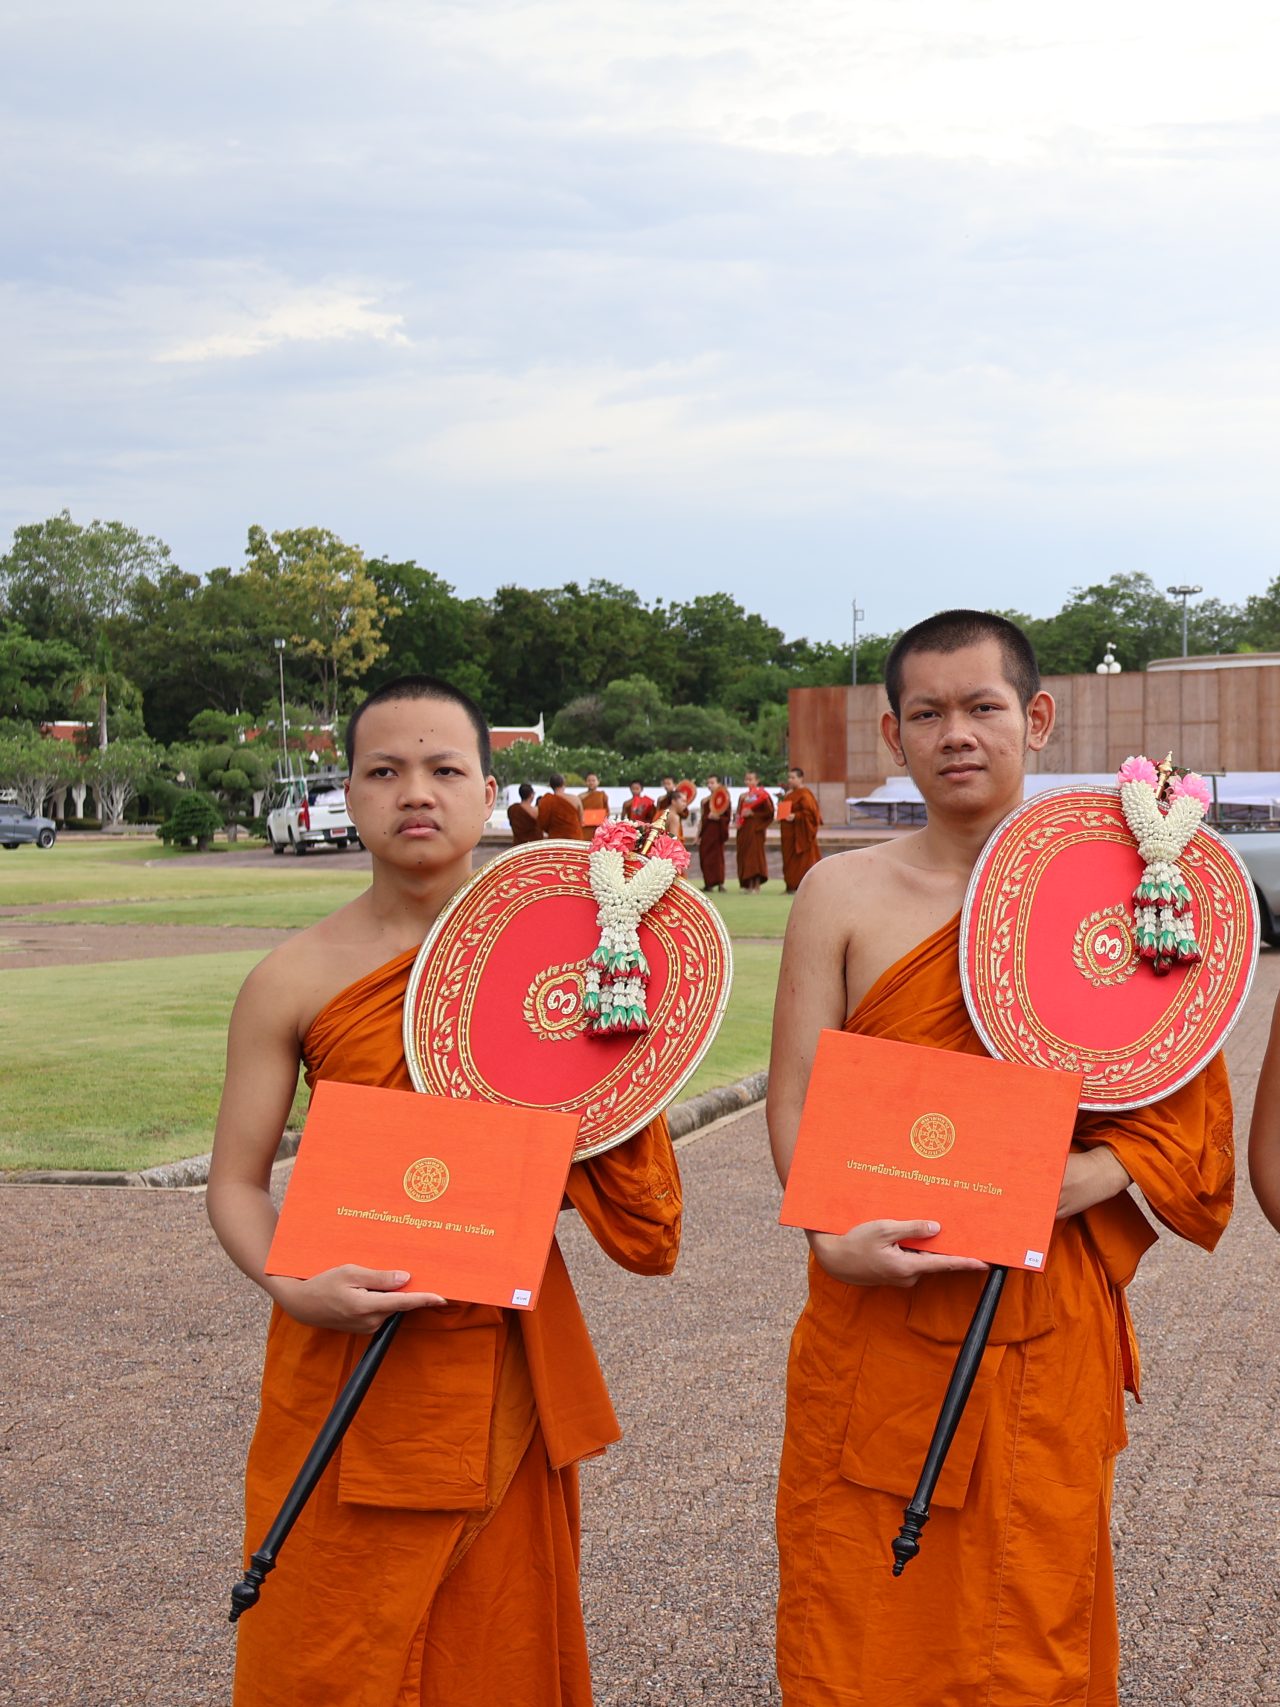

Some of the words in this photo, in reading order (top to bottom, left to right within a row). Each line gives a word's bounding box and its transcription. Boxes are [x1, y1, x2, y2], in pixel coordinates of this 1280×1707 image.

[1094, 934, 1123, 960] ๓
[547, 989, 577, 1015] ๓
[847, 1159, 951, 1187] ประกาศนียบัตรเปรียญธรรม
[954, 1180, 970, 1190] สาม
[973, 1182, 1003, 1196] ประโยค
[337, 1206, 443, 1229] ประกาศนียบัตรเปรียญธรรม
[445, 1223, 462, 1232] สาม
[464, 1224, 495, 1236] ประโยค
